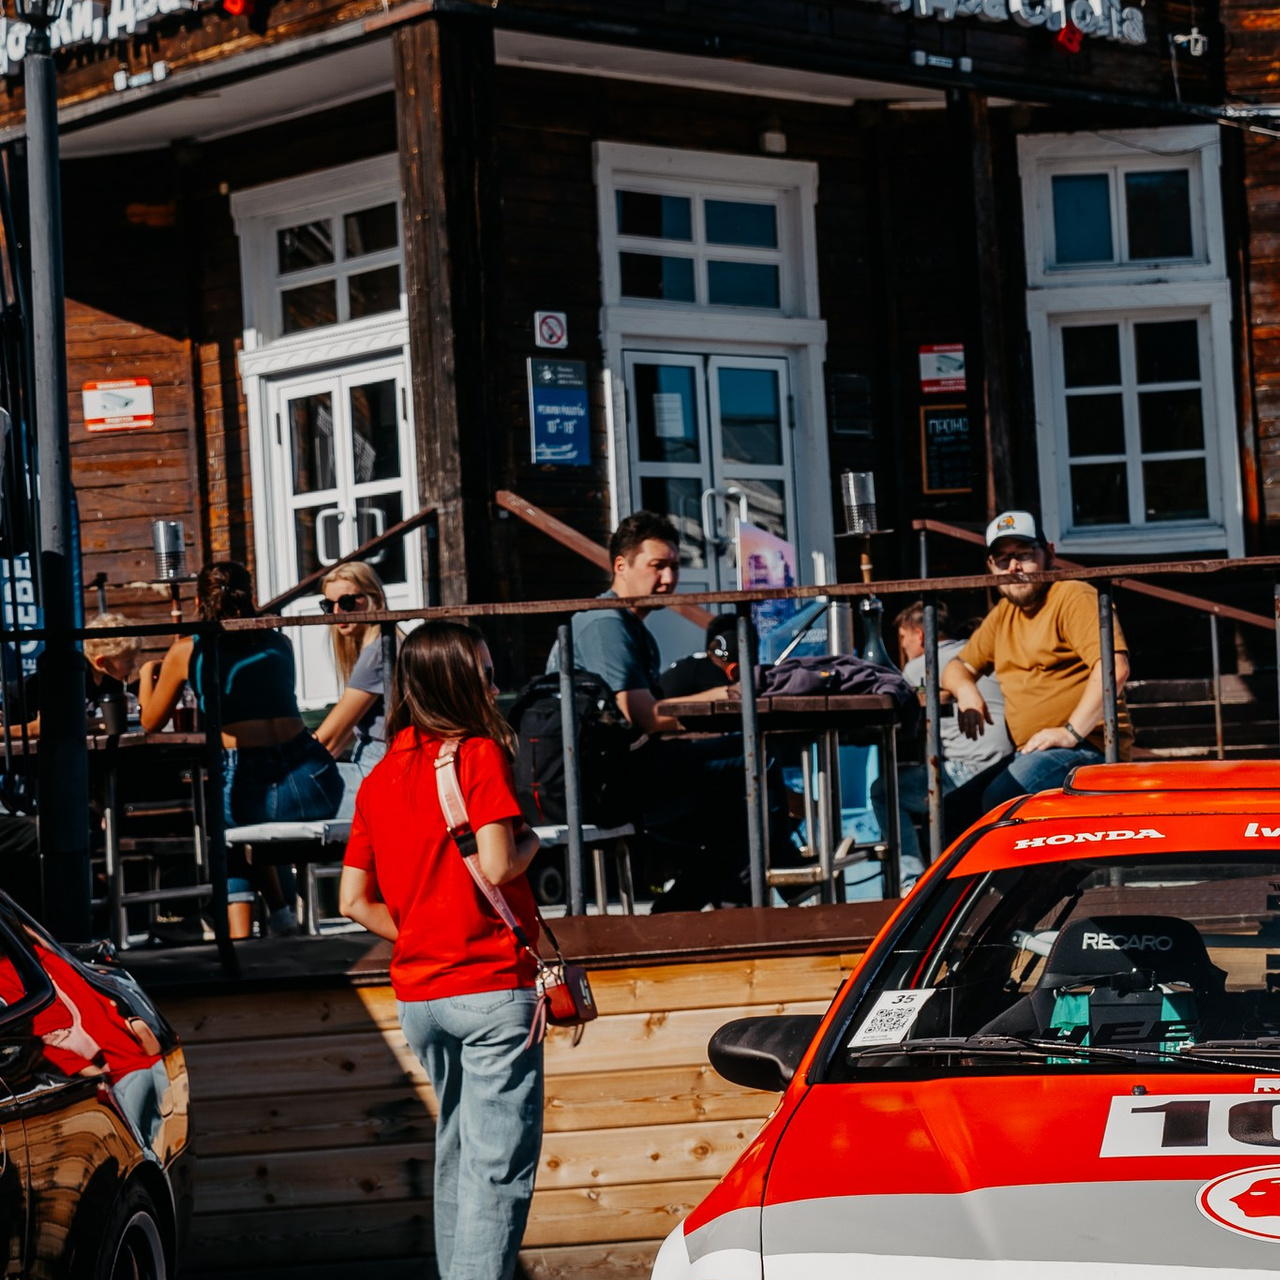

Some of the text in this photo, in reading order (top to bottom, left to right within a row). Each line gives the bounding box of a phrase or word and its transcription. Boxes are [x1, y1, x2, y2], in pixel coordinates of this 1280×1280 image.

[1014, 828, 1166, 850] HONDA
[1082, 932, 1173, 951] RECARO
[891, 994, 918, 1005] 35
